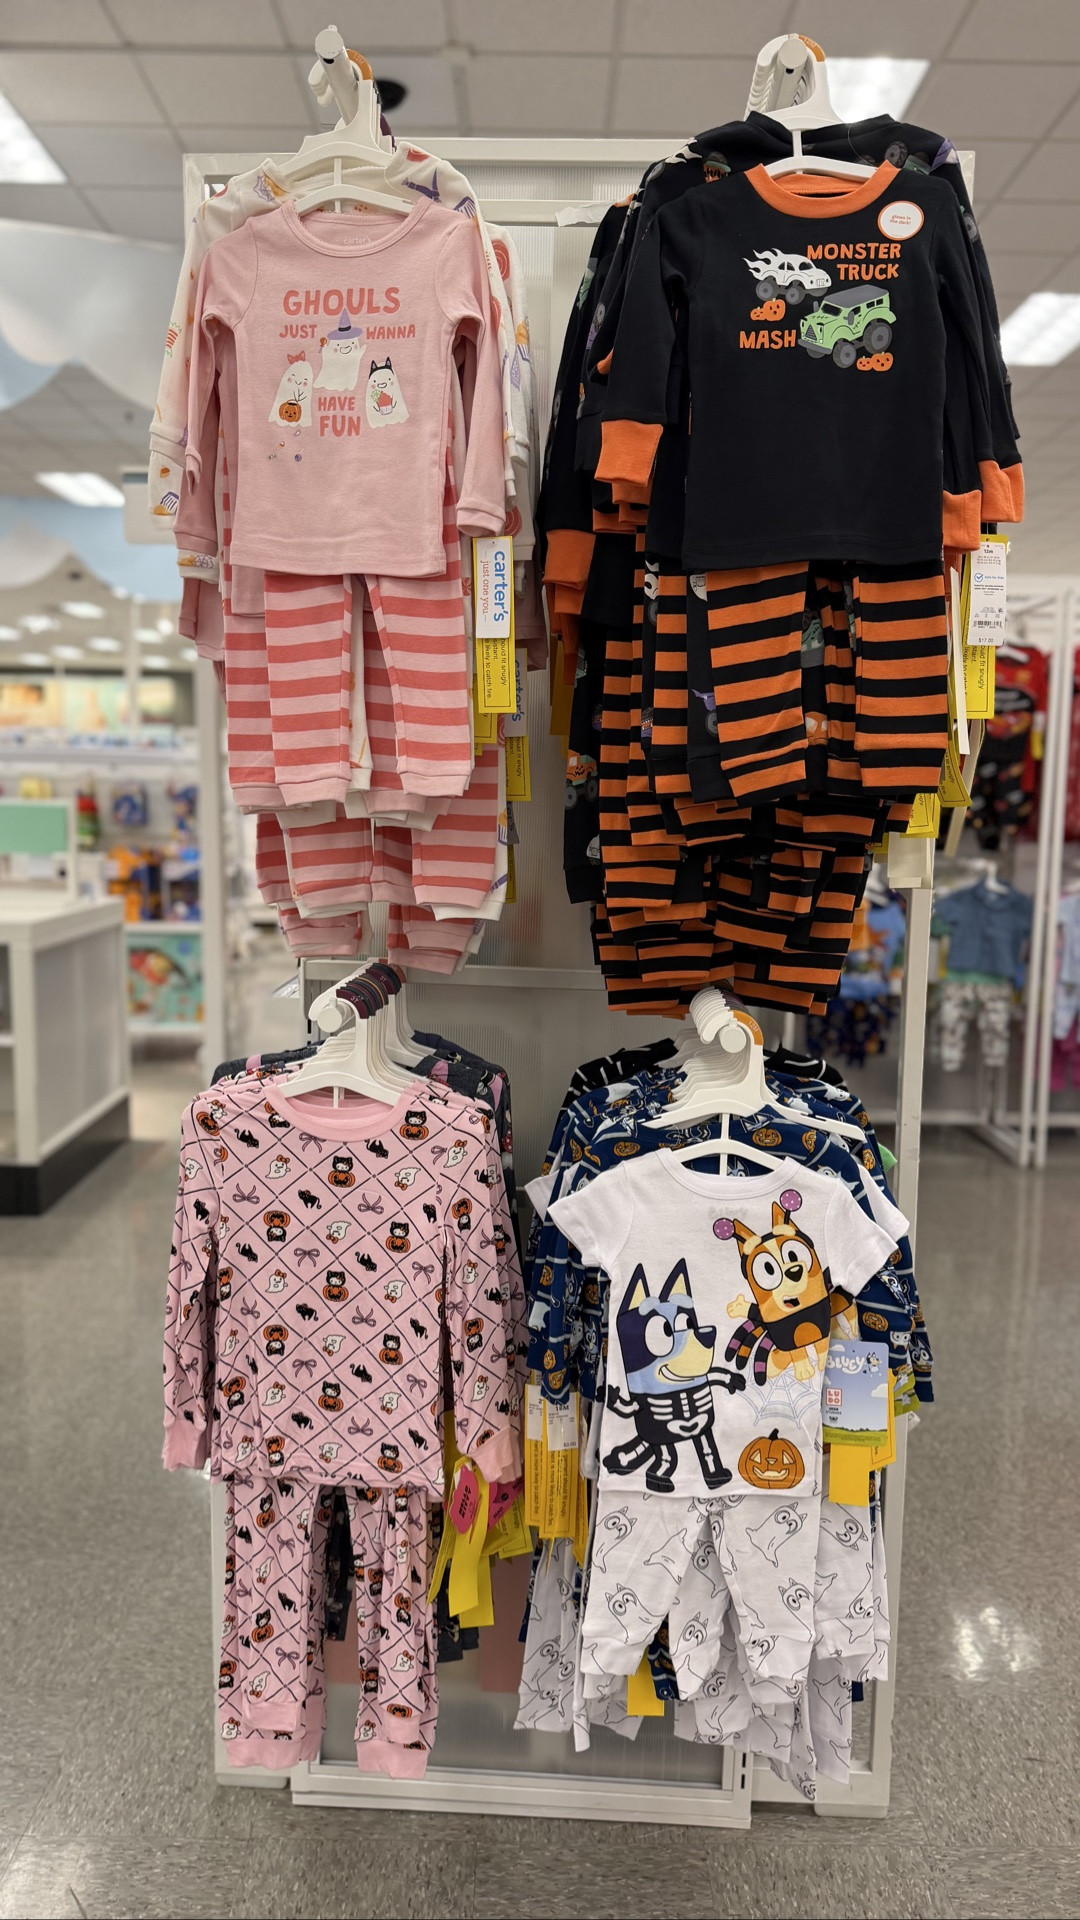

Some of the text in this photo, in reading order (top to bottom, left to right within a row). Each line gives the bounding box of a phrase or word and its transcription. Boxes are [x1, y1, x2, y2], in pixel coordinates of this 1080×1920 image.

[806, 242, 902, 260] MONSTER
[836, 263, 900, 281] TRUCK
[282, 287, 401, 316] GHOULS
[279, 323, 416, 340] JUST WANNA
[739, 329, 797, 350] MASH
[317, 396, 356, 412] HAVE
[319, 415, 361, 437] FUN
[480, 560, 491, 578] just
[493, 550, 508, 622] carter's
[350, 995, 359, 1004] 3T
